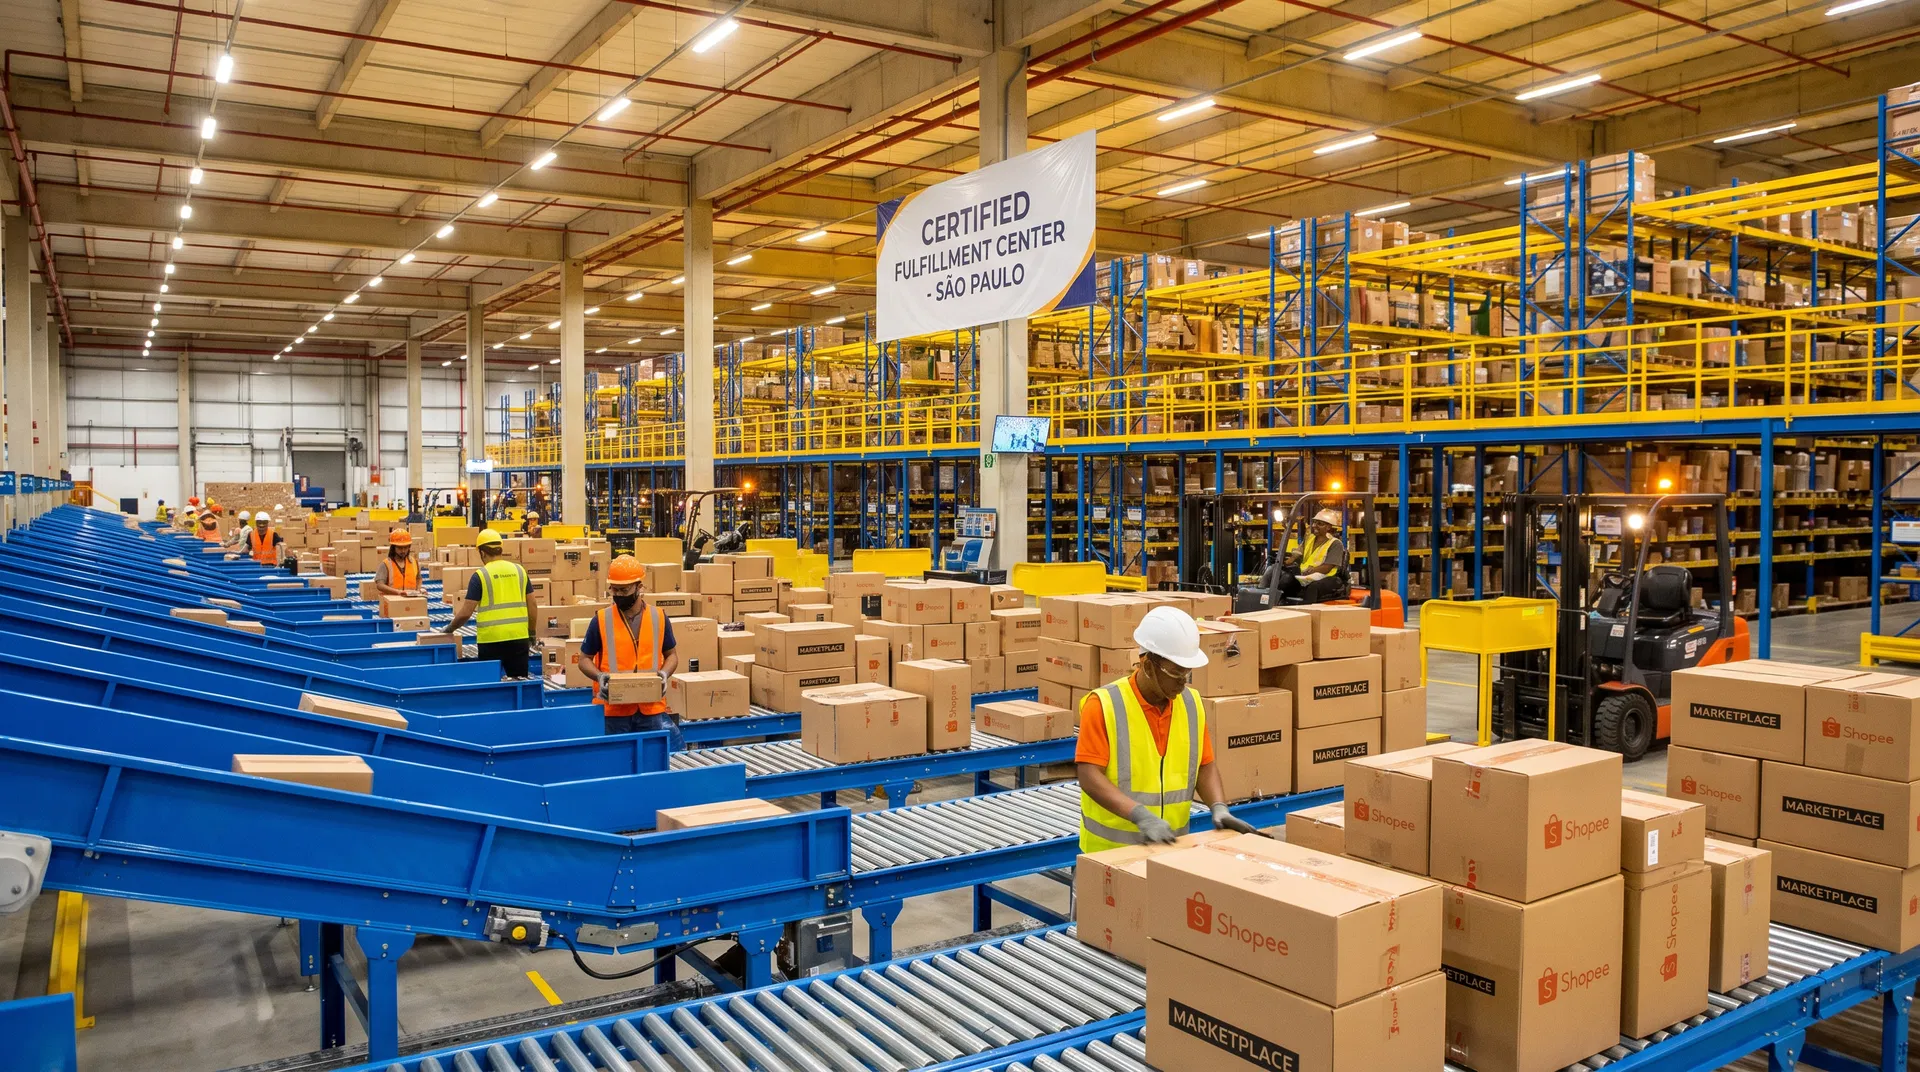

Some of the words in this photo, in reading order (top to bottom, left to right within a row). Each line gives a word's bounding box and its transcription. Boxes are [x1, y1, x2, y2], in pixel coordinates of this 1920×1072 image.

[921, 190, 1030, 246] CERTIFIED
[894, 238, 992, 282] FULFILLMENT
[996, 219, 1065, 257] CENTER
[935, 274, 966, 302] SÃO
[970, 262, 1025, 295] PAULO
[799, 644, 844, 654] MARKETPLACE
[1280, 637, 1304, 649] Shopee
[1315, 682, 1366, 698] MARKETPLACE
[1693, 705, 1777, 728] MARKETPLACE
[1229, 732, 1279, 748] MARKETPLACE
[1843, 726, 1894, 745] Shopee
[1315, 745, 1365, 761] MARKETPLACE
[1699, 784, 1742, 803] Shopee
[1371, 808, 1416, 832] Shopee
[1786, 799, 1881, 828] MARKETPLACE
[1565, 816, 1610, 841] Shopee
[1780, 878, 1874, 911] MARKETPLACE
[1666, 883, 1680, 949] Shopee
[1217, 912, 1289, 957] Shopee
[1441, 967, 1492, 993] ETPLACE
[1560, 962, 1610, 992] Shopee
[1173, 1006, 1293, 1072] MARKETPLACE
